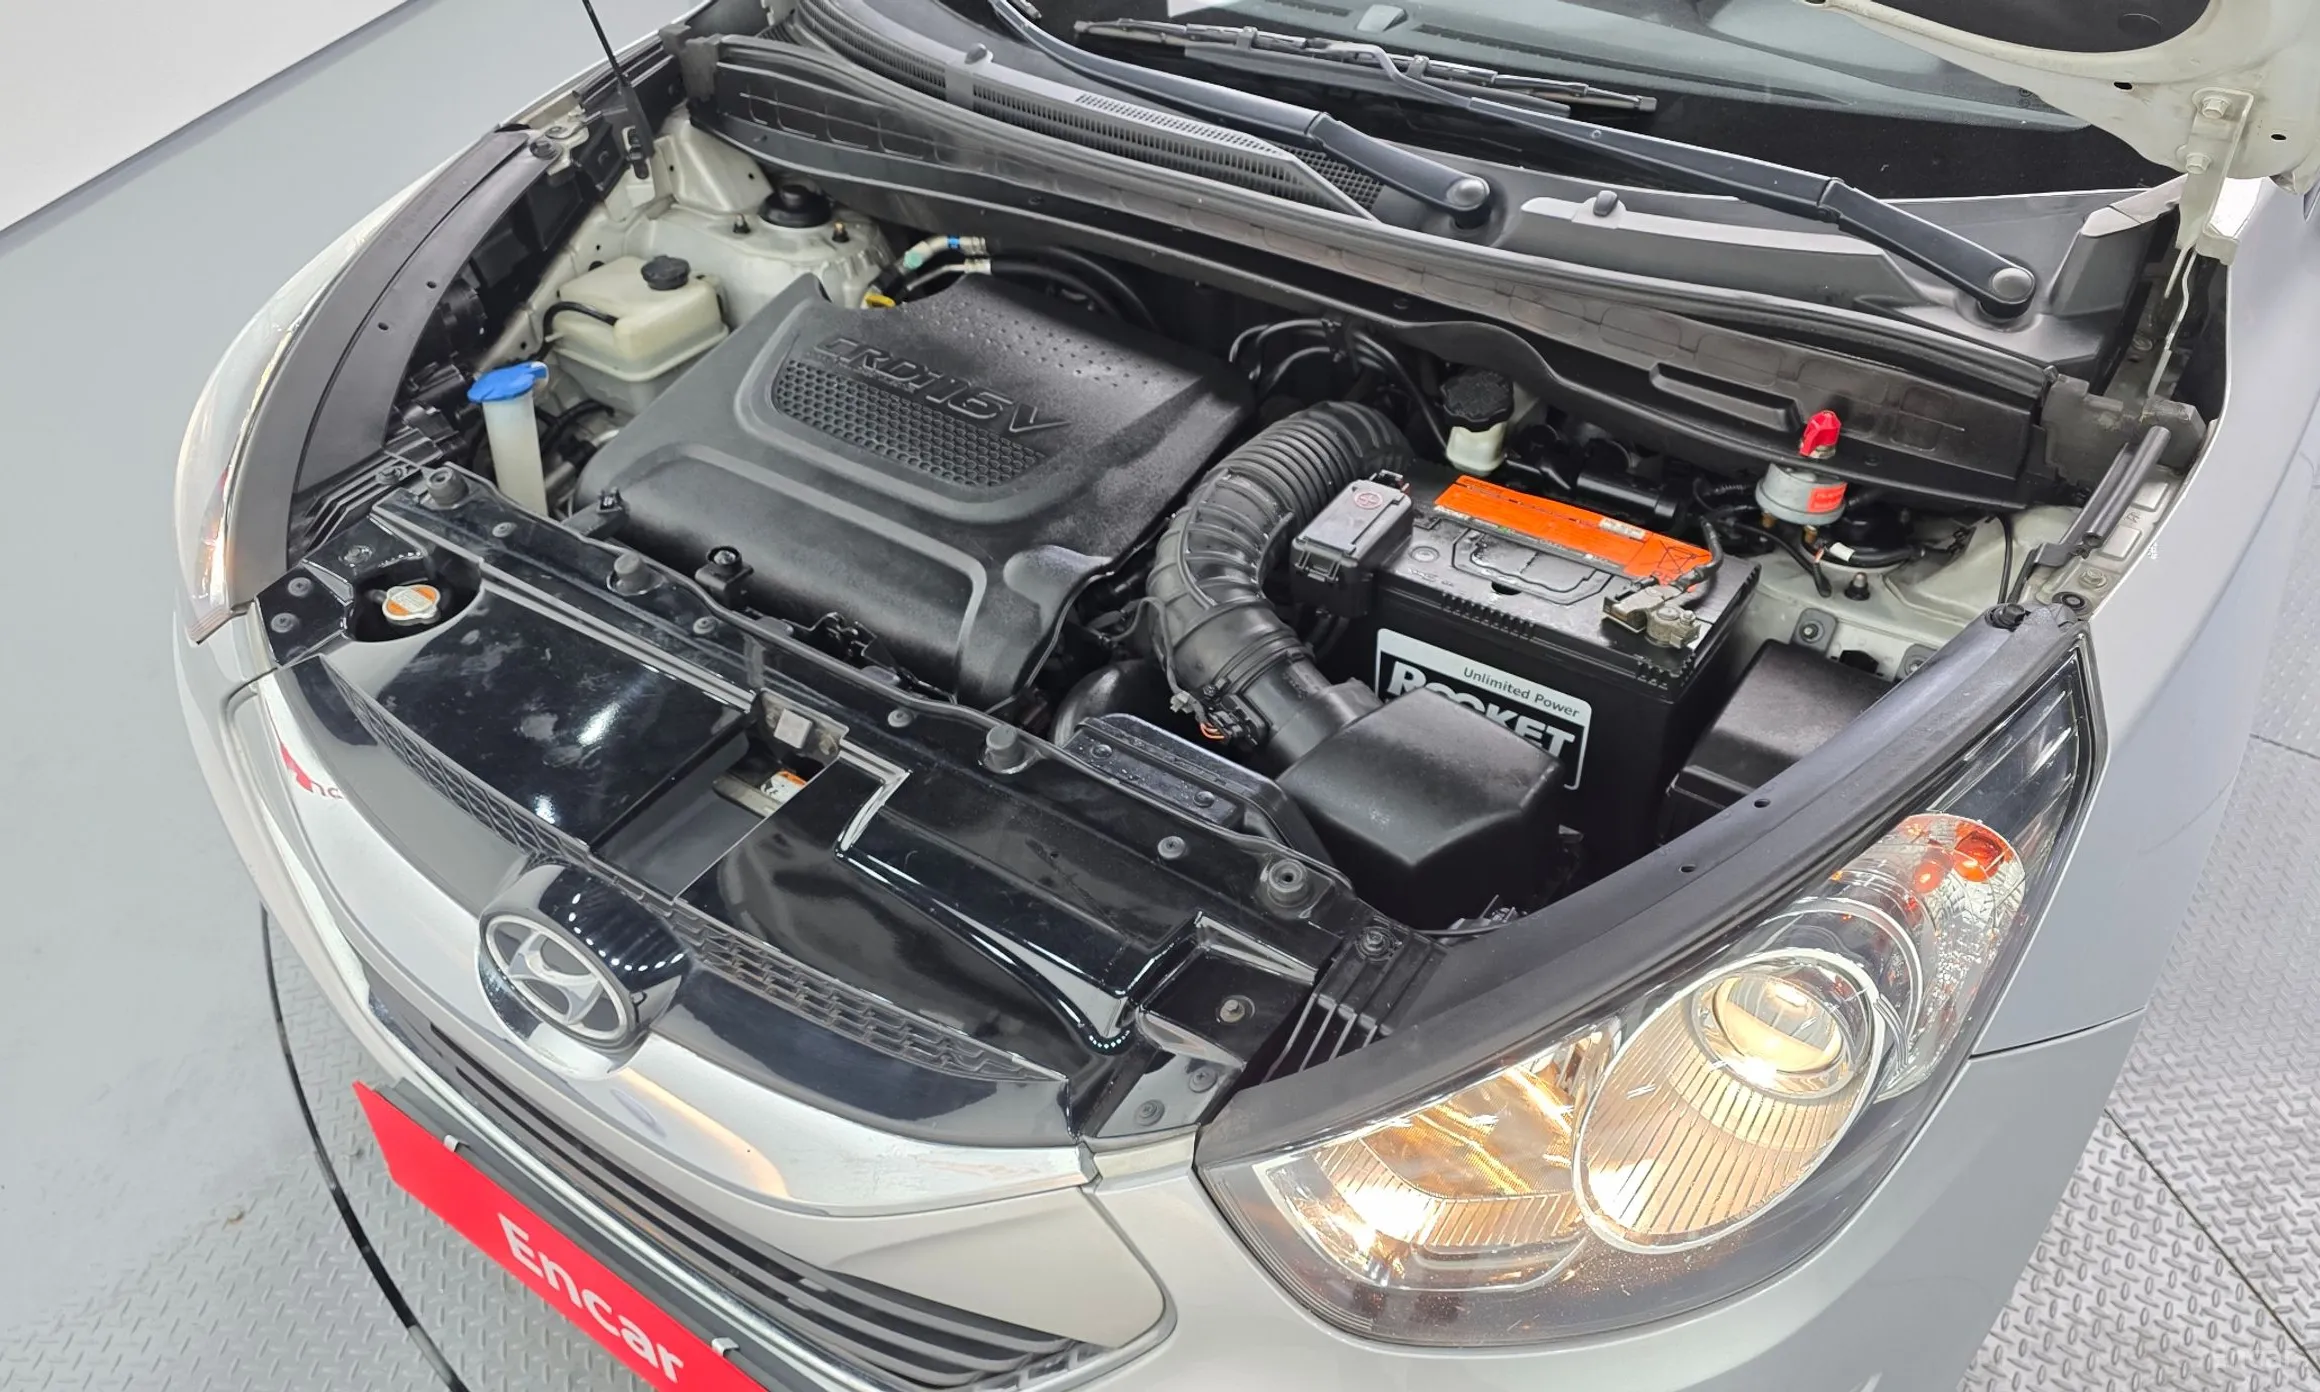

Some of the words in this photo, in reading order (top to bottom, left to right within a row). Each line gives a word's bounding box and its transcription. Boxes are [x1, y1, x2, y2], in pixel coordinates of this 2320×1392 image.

[1463, 666, 1531, 700] Unlimited
[1534, 692, 1580, 718] Power
[497, 1211, 685, 1384] Encar
